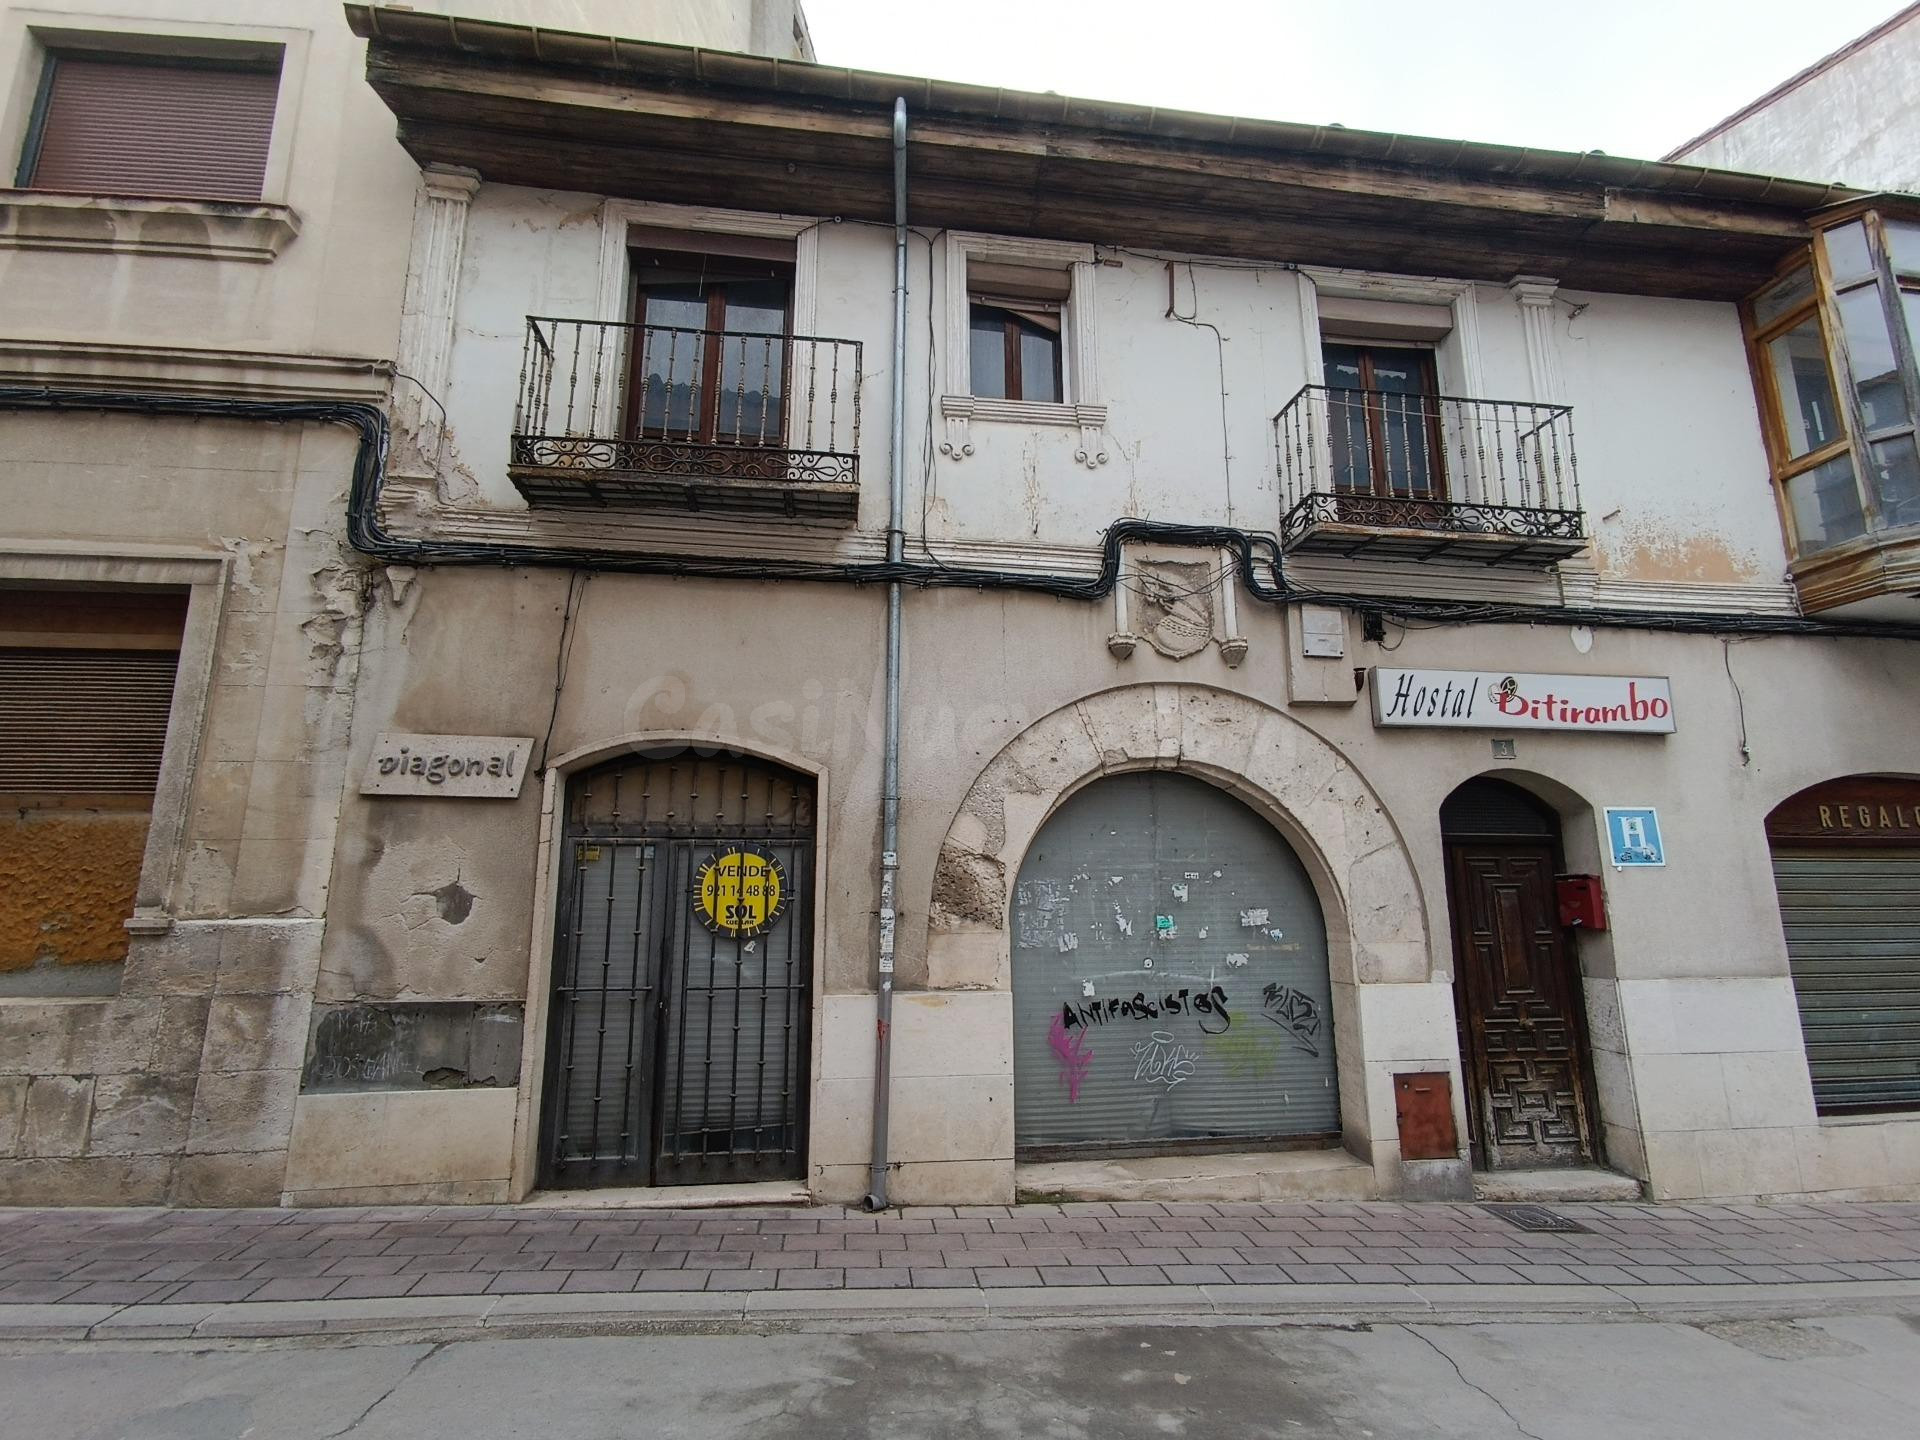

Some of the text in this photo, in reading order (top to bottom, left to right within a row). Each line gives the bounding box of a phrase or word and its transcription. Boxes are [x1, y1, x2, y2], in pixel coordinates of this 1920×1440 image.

[1386, 673, 1668, 724] Hostal Ditirambo
[718, 865, 769, 877] VENDE
[746, 884, 759, 897] 48
[725, 904, 757, 919] SOL
